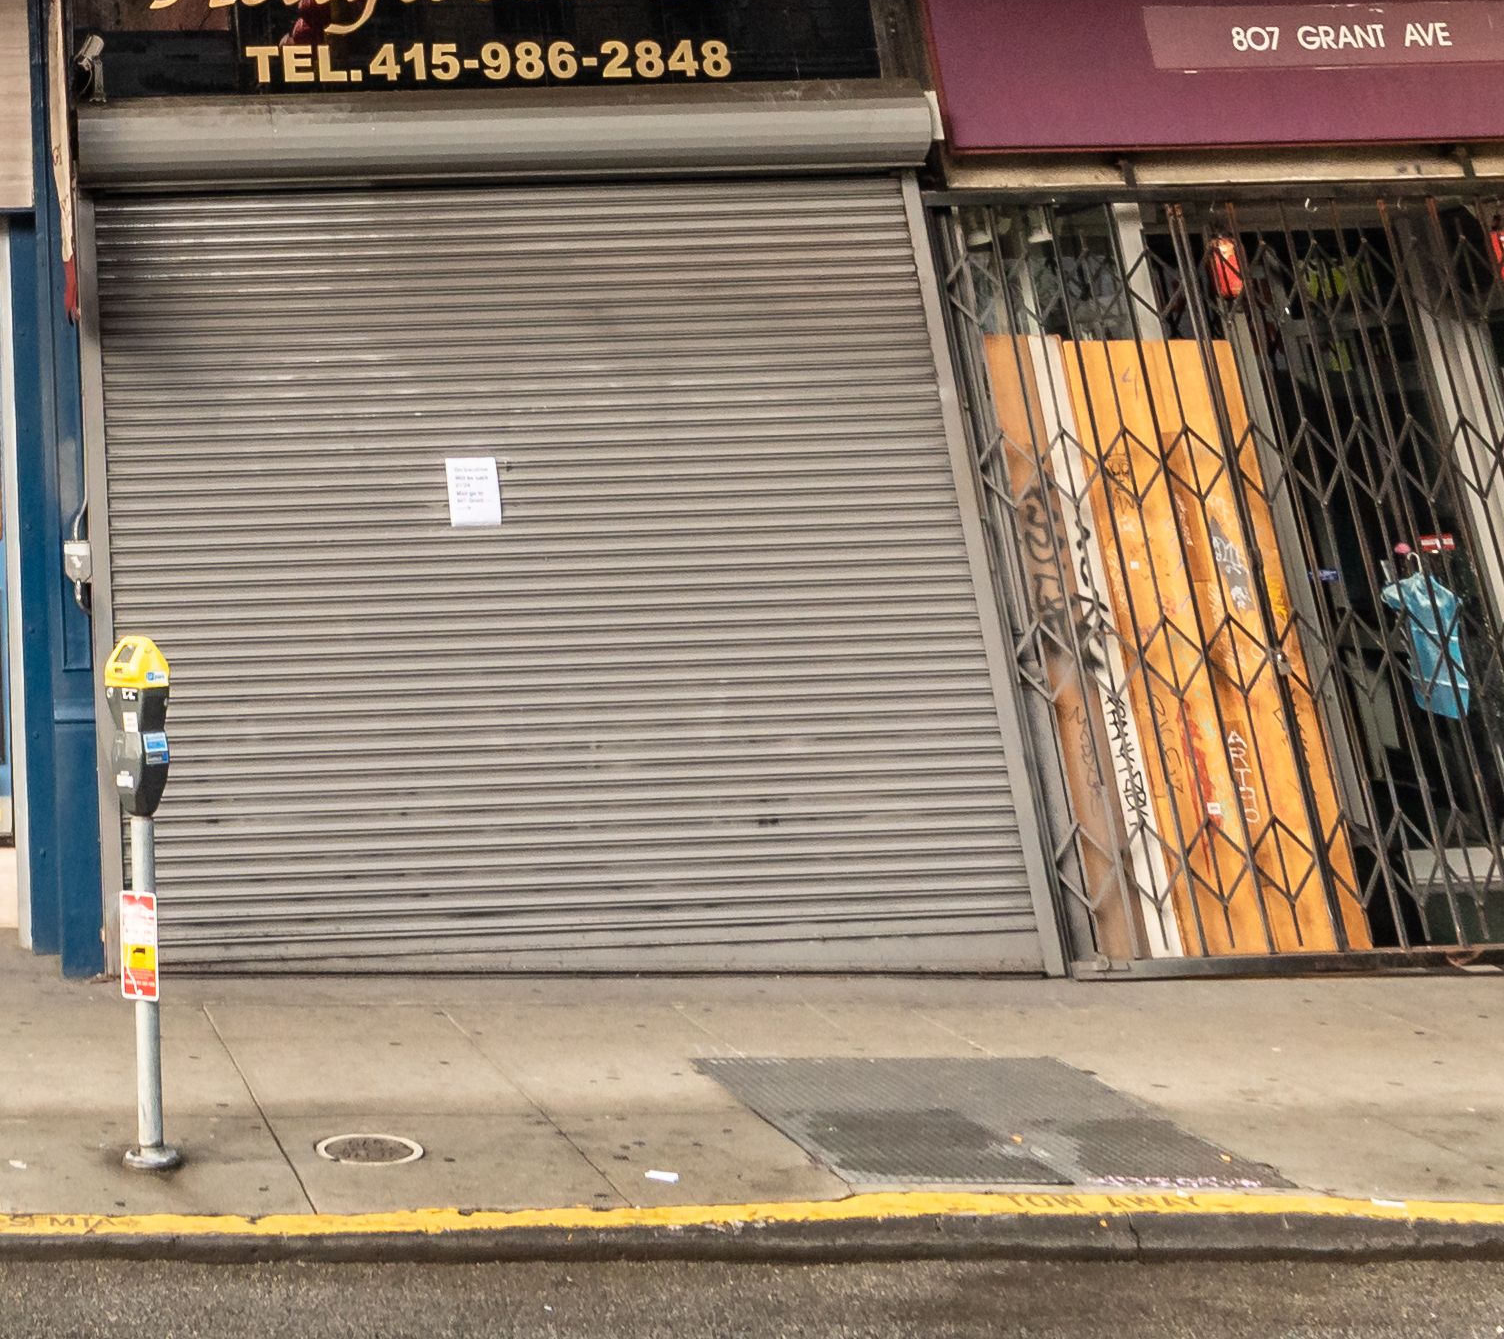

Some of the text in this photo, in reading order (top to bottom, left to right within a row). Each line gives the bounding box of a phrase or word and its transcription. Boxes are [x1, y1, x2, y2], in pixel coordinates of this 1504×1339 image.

[1231, 22, 1453, 52] 807 GRANT AVE
